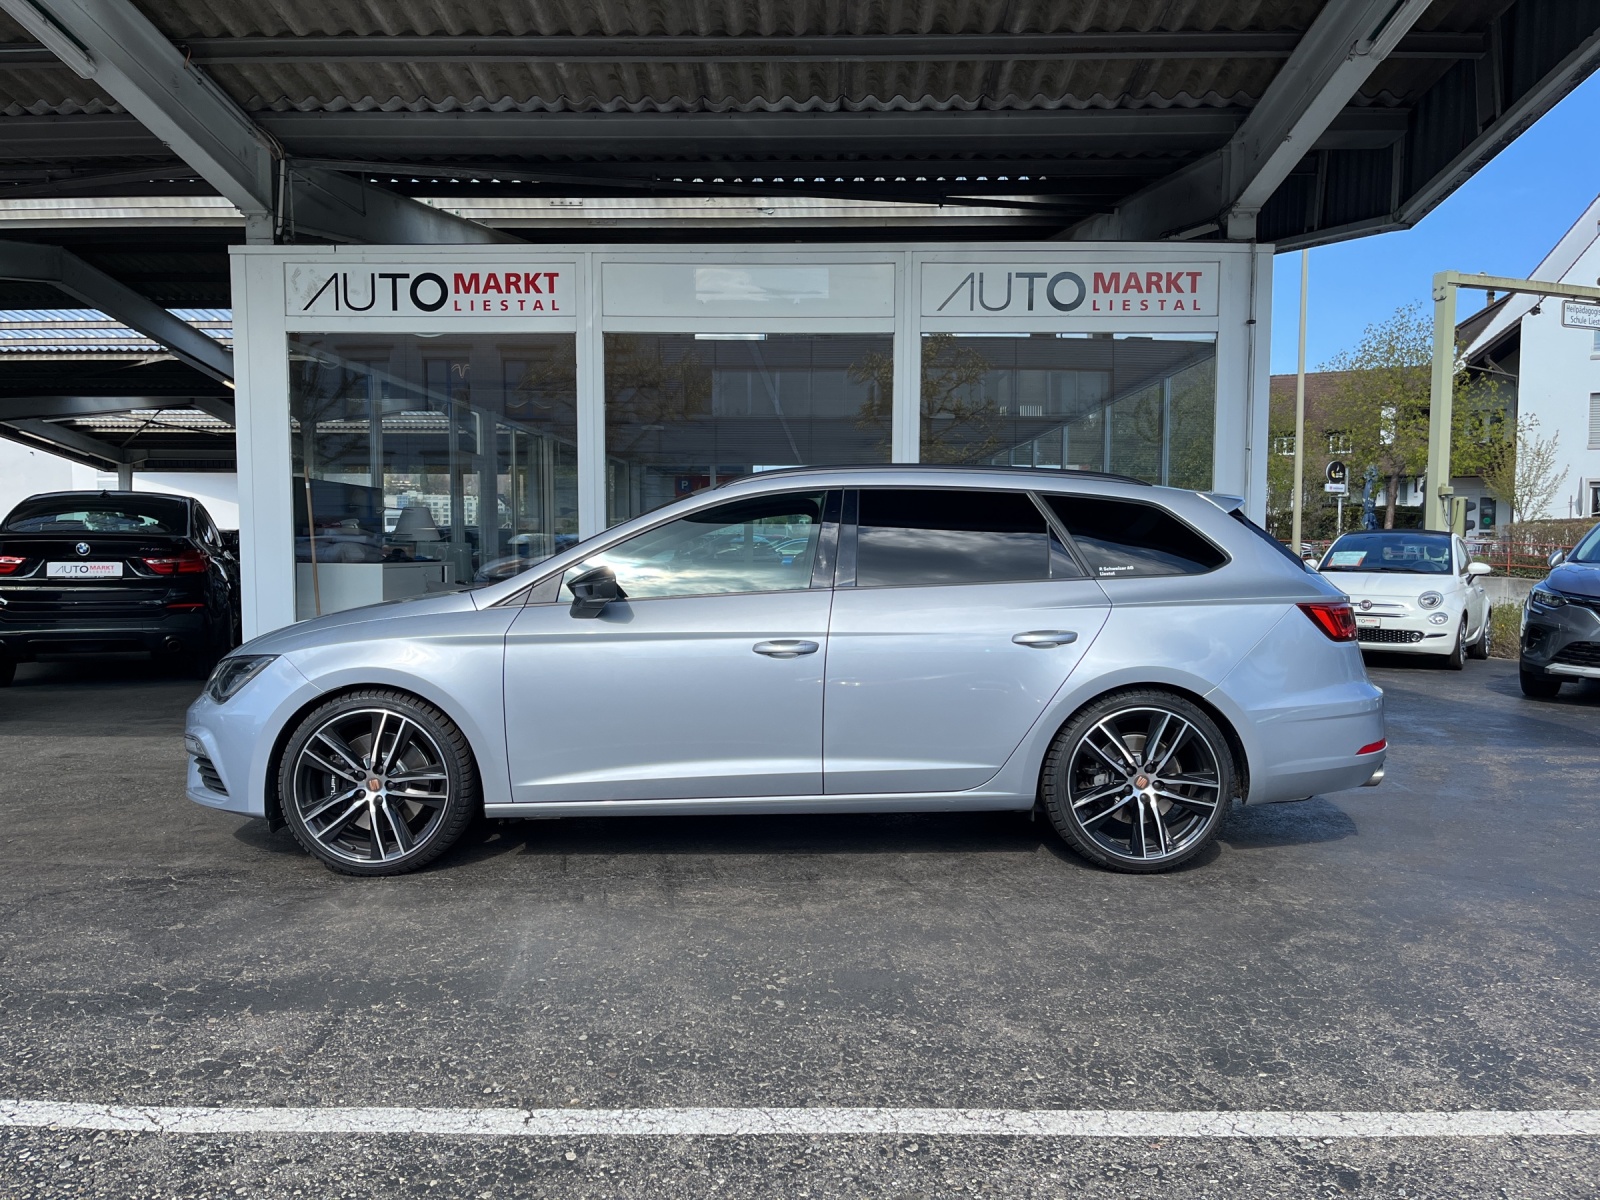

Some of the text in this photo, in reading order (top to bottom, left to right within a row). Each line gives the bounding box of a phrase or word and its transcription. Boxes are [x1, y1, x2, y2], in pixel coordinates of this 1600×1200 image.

[302, 272, 560, 312] AUTO MARKT
[936, 271, 1203, 312] AUTO MARKT
[453, 299, 560, 311] LIESTAL
[1092, 299, 1201, 311] LIESTAL
[1570, 315, 1587, 324] Schule
[681, 480, 689, 490] P
[55, 565, 89, 573] AUTO
